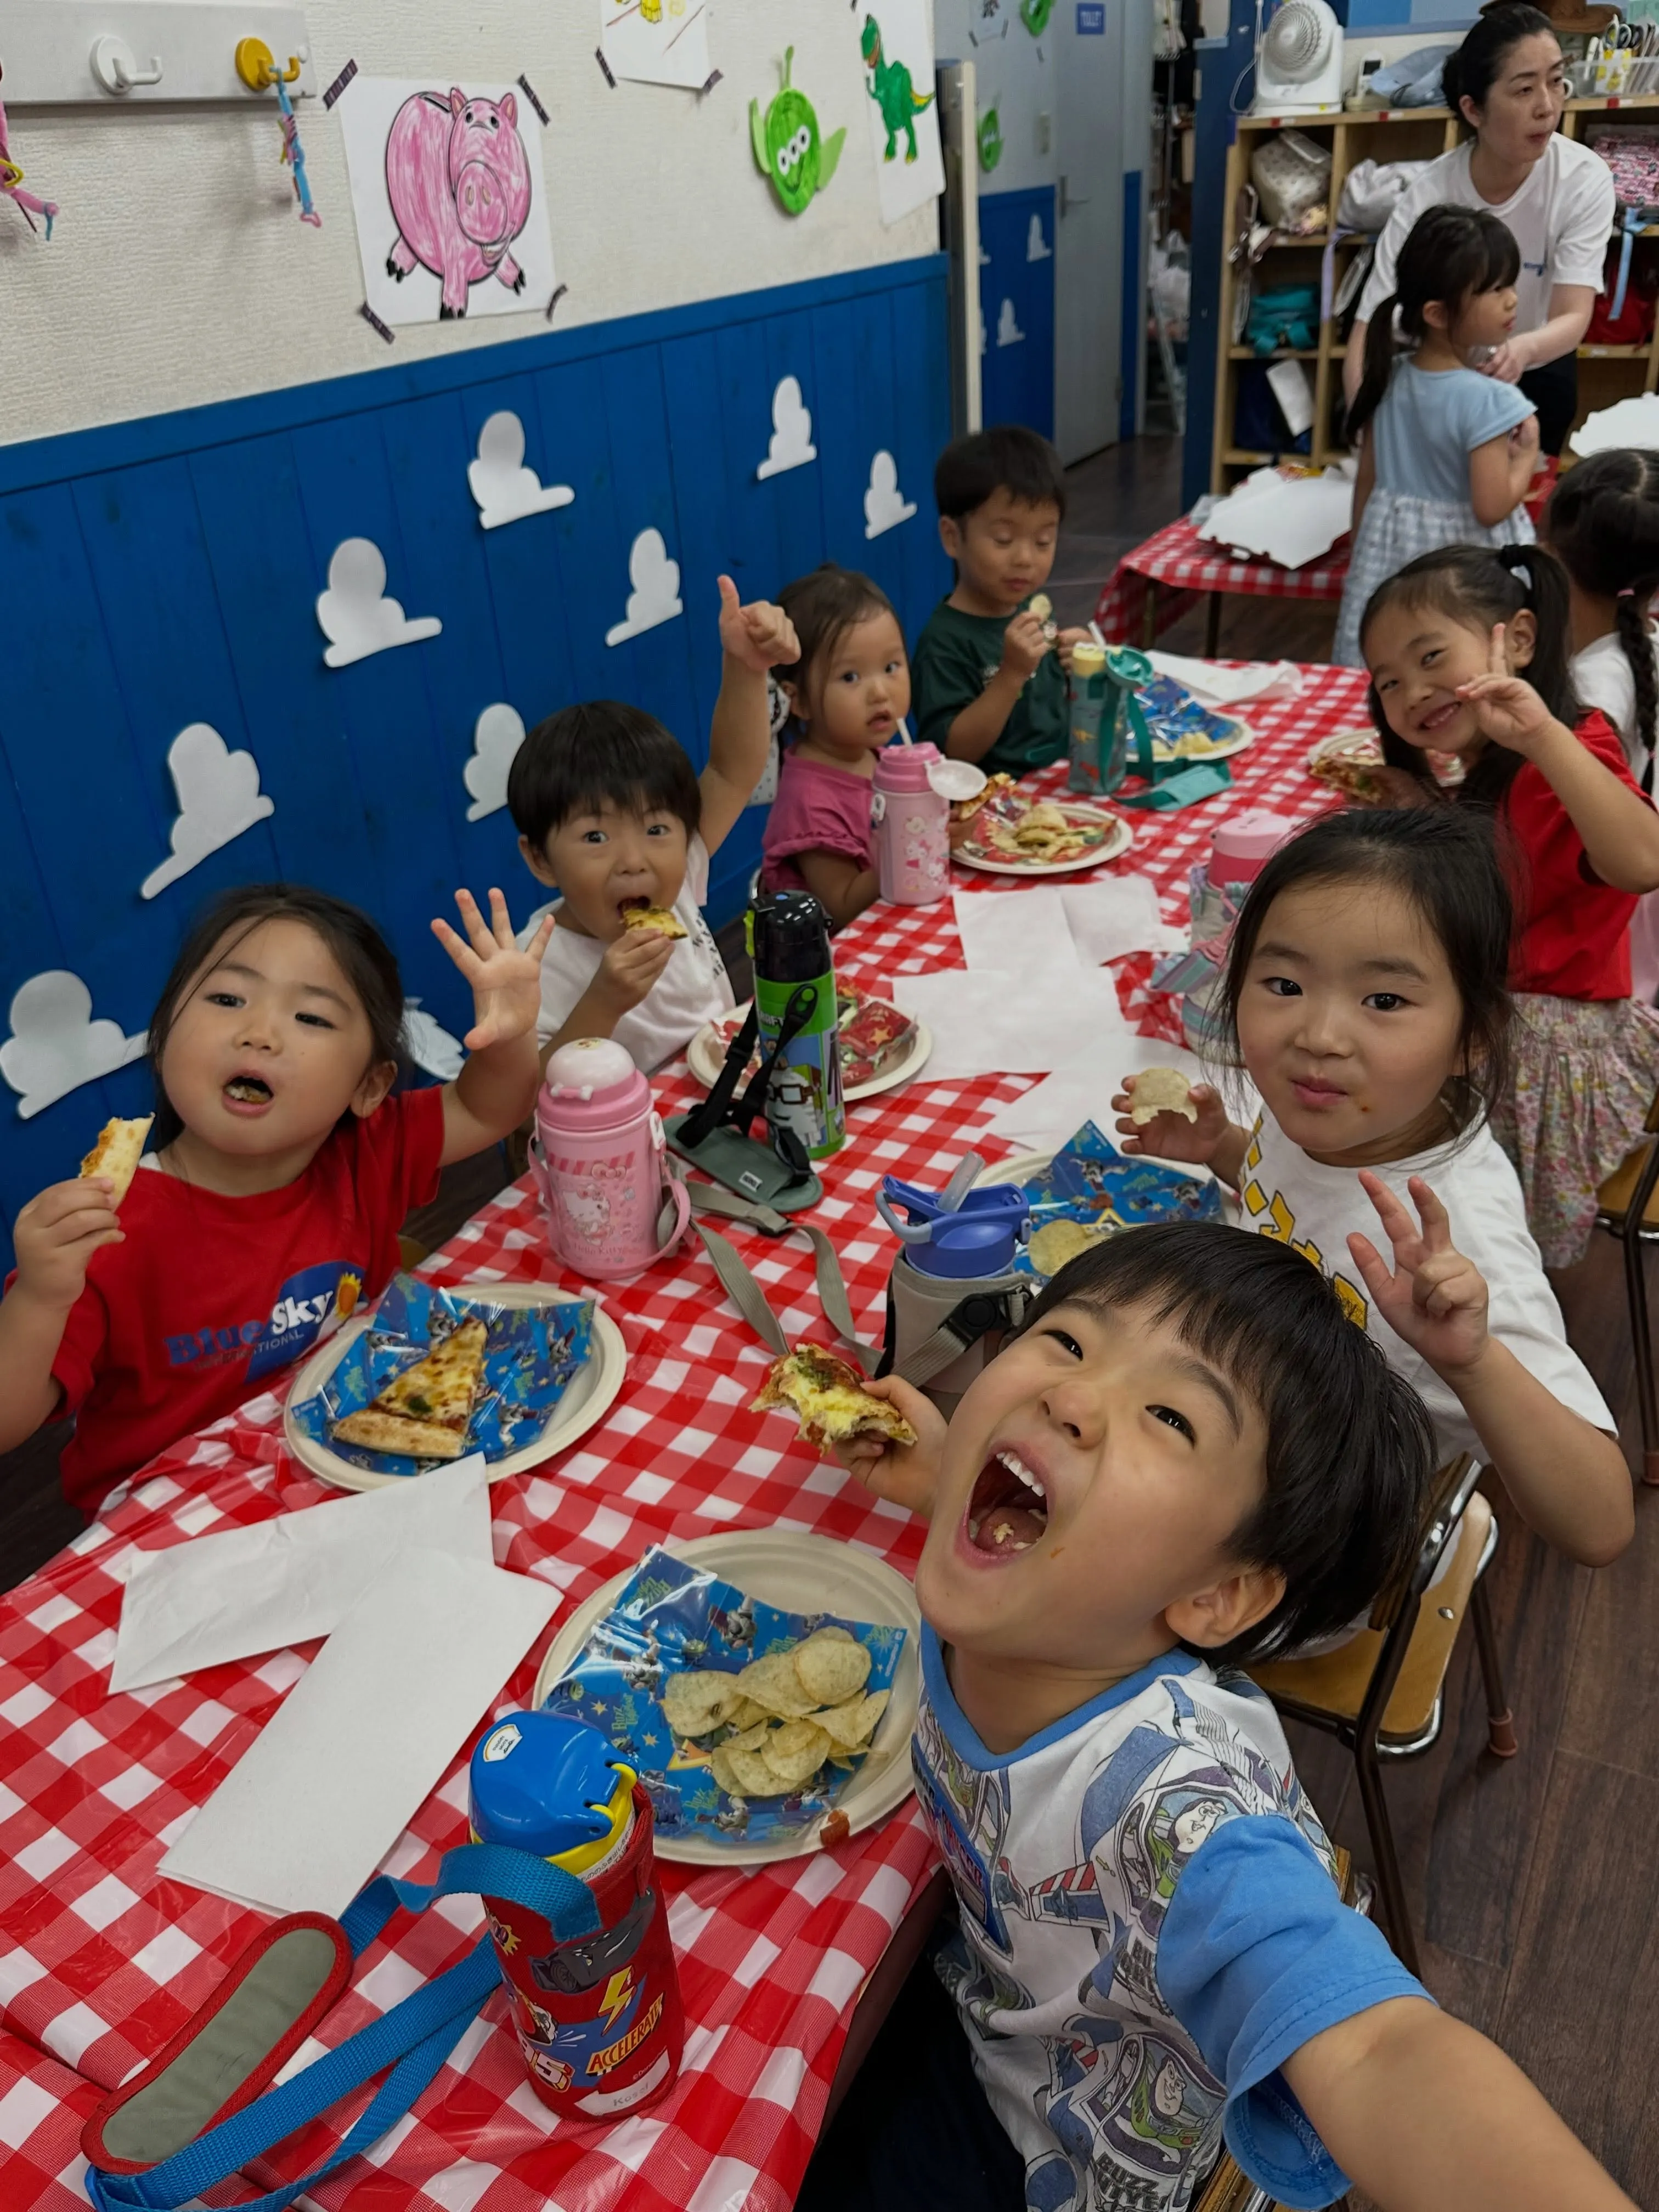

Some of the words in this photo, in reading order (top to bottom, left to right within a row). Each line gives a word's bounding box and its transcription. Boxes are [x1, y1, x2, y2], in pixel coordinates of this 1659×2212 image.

[164, 1320, 263, 1366] Blue
[272, 1290, 333, 1334] Sky
[589, 2001, 660, 2072] ACCELERATE
[1096, 2151, 1159, 2190] BUZZ
